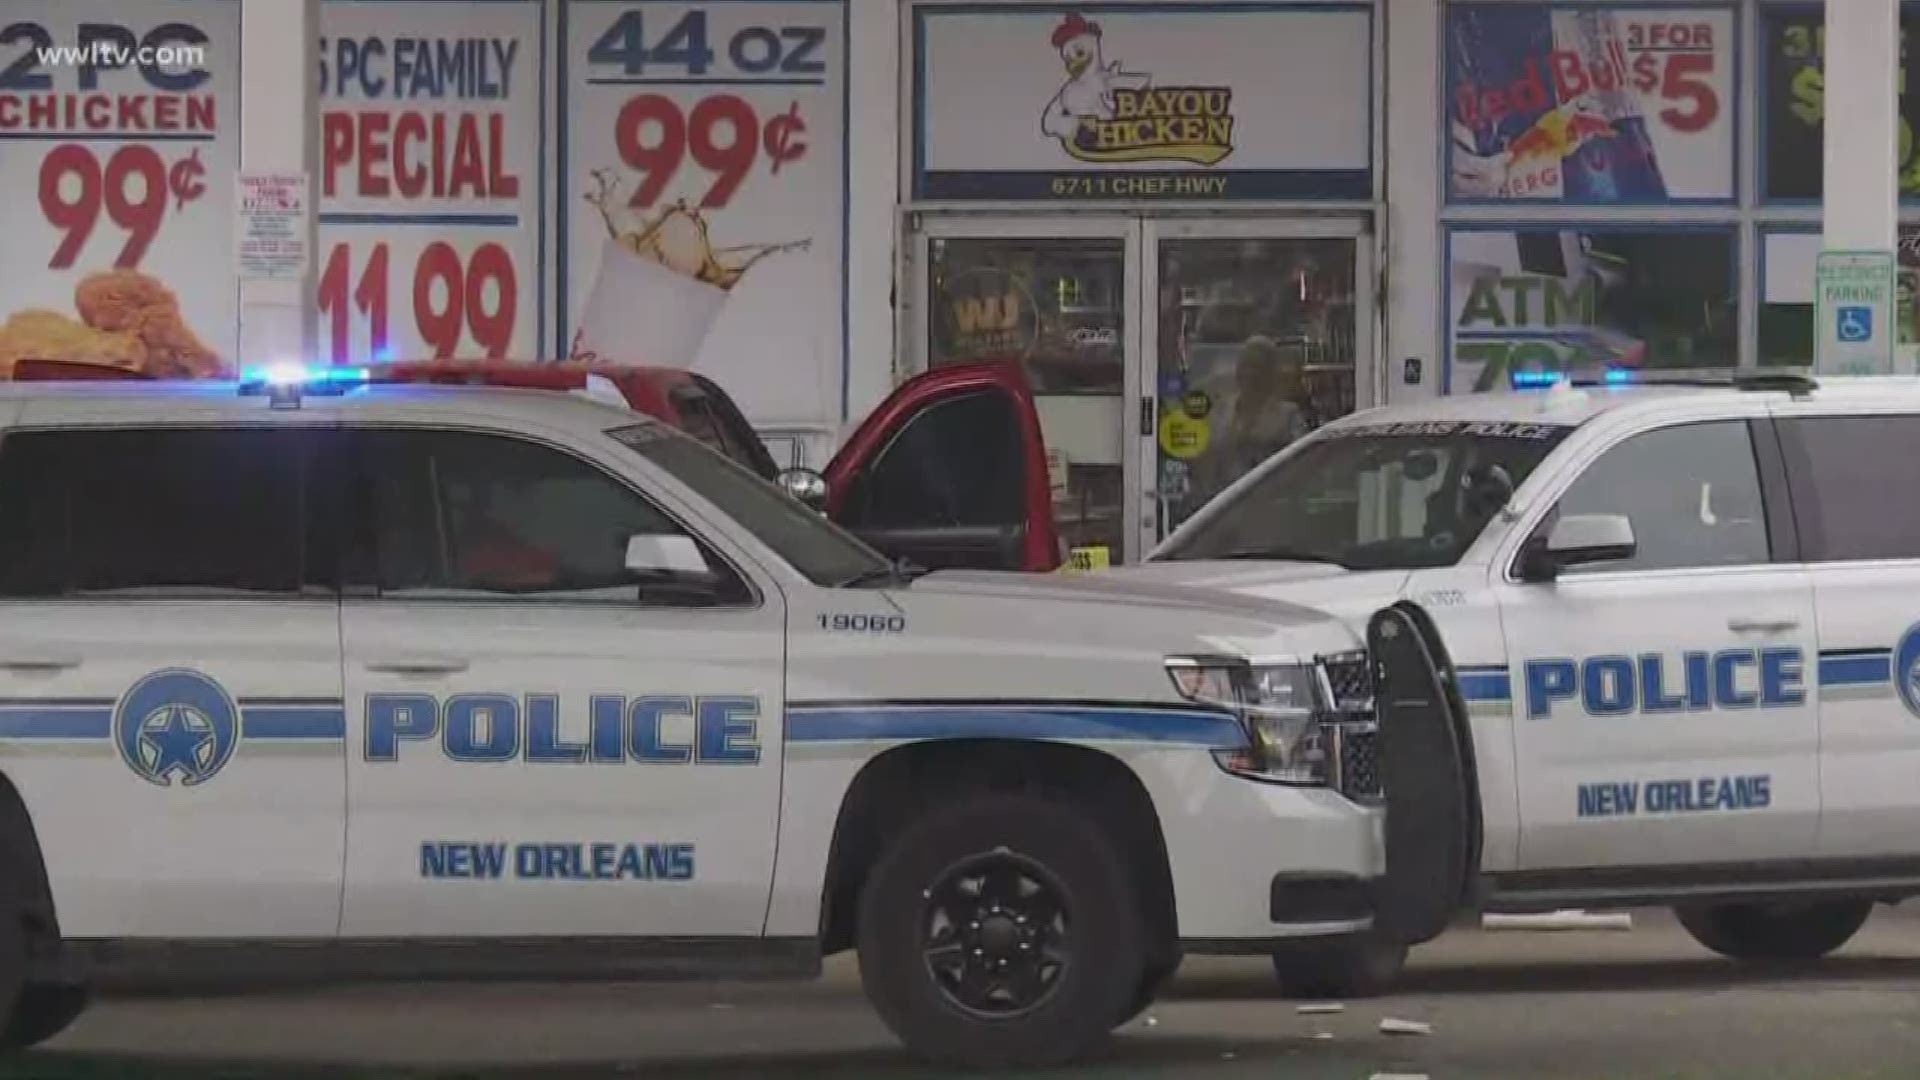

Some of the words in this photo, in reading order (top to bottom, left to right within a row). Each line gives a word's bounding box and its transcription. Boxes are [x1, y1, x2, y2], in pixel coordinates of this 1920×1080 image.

[587, 10, 714, 75] 44
[1628, 25, 1643, 46] 3
[1650, 24, 1714, 46] FOR
[0, 24, 53, 91] 2
[77, 23, 212, 91] PC
[337, 37, 386, 98] PC
[394, 38, 519, 98] FAMILY
[0, 94, 215, 131] CHICKEN
[1116, 89, 1231, 119] BAYOU
[1633, 53, 1720, 134] $5
[322, 112, 519, 199] PECIAL
[1070, 116, 1233, 152] CHICKEN
[1052, 177, 1106, 195] 6711
[1113, 176, 1172, 194] CHEF
[1176, 176, 1227, 195] HWY
[1458, 277, 1596, 327] ATM
[1826, 286, 1883, 301] PARKING
[816, 613, 905, 633] 19060
[1524, 647, 1807, 720] POLICE
[363, 692, 762, 765] POLICE
[1577, 780, 1639, 817] NEW
[1644, 774, 1772, 812] ORLEANS
[419, 842, 507, 879] NEW
[514, 842, 694, 880] ORLEANS
